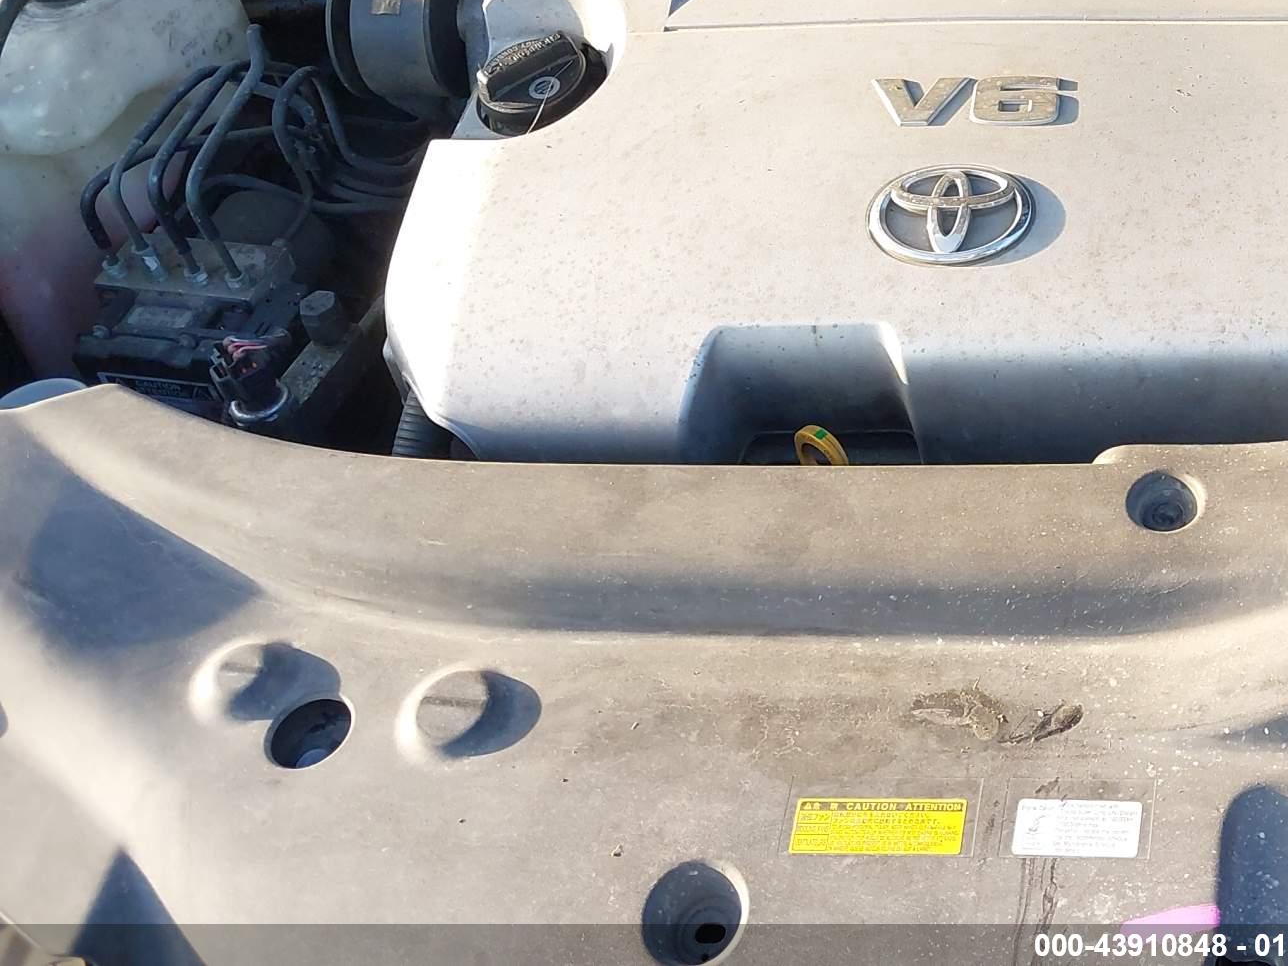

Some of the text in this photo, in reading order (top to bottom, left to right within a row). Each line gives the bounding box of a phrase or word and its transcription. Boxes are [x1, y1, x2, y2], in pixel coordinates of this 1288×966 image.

[872, 76, 1061, 125] V6
[846, 802, 897, 811] CAUTION
[905, 802, 962, 811] ATTENTION
